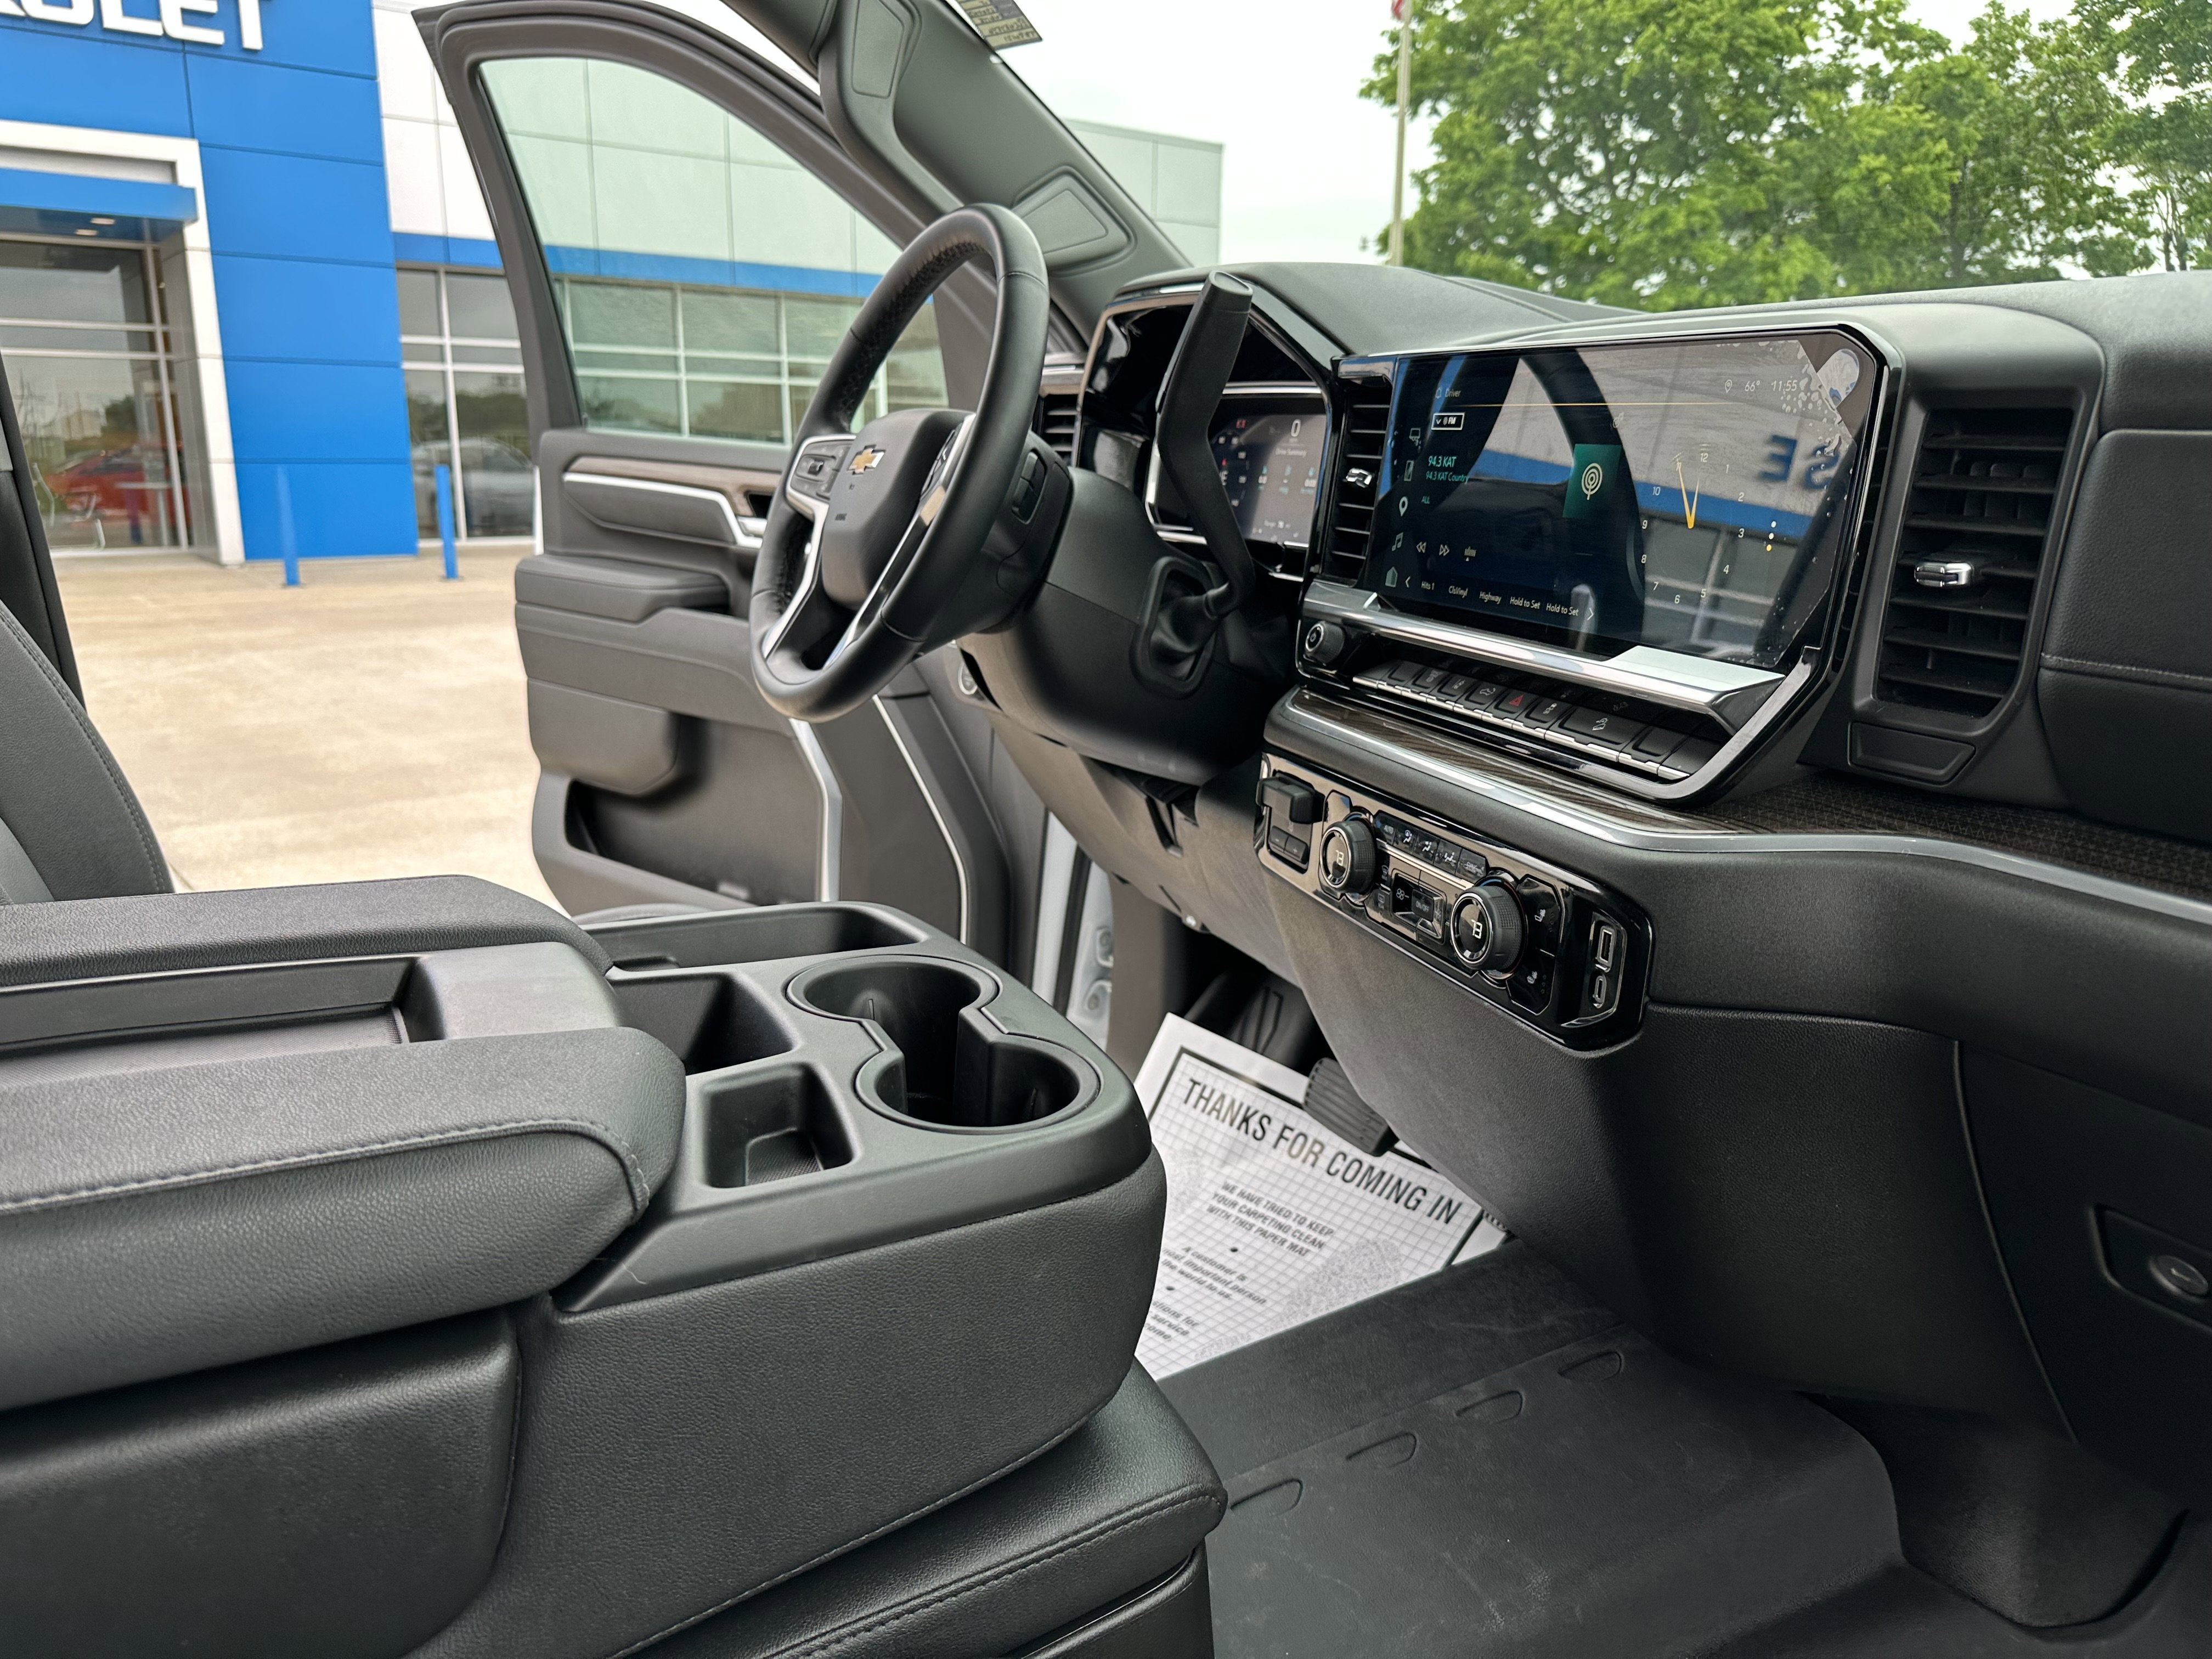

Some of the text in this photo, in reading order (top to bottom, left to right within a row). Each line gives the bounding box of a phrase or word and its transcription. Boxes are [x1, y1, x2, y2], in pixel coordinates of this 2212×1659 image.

[0, 0, 263, 50] LET
[1771, 379, 1798, 392] 11:55
[1444, 387, 1462, 398] Driver
[1428, 455, 1458, 468] 94.3 KAT
[1700, 453, 1709, 463] 12
[1725, 464, 1730, 474] 1
[1426, 471, 1470, 485] 94.3 KAT Country
[1652, 486, 1661, 496] 10
[1737, 492, 1745, 502] 2
[1641, 520, 1648, 529] 9
[1737, 528, 1745, 538] 3
[1641, 554, 1647, 564] 8
[1723, 565, 1730, 575] 4
[1421, 581, 1431, 590] Hits
[1652, 581, 1659, 591] 7
[1479, 591, 1502, 605] Highway
[1674, 594, 1680, 604] 6
[1701, 588, 1707, 599] 5
[1510, 596, 1541, 610] Hold to Set
[1545, 602, 1579, 617] Hold to Set
[1183, 1077, 1463, 1224] THANKS FOR COMING IN
[1221, 1181, 1335, 1236] WE HAVE TRIED TO KEEP
[1211, 1191, 1327, 1249] YOUR CARPETING CLEAN
[1206, 1204, 1312, 1257] WITH THIS PAPER MAT
[1190, 1251, 1237, 1276] customer
[1178, 1268, 1207, 1285] world
[1183, 1259, 1233, 1287] important
[1229, 1284, 1267, 1305] person
[1151, 1314, 1190, 1336] service
[1182, 1316, 1200, 1327] for
